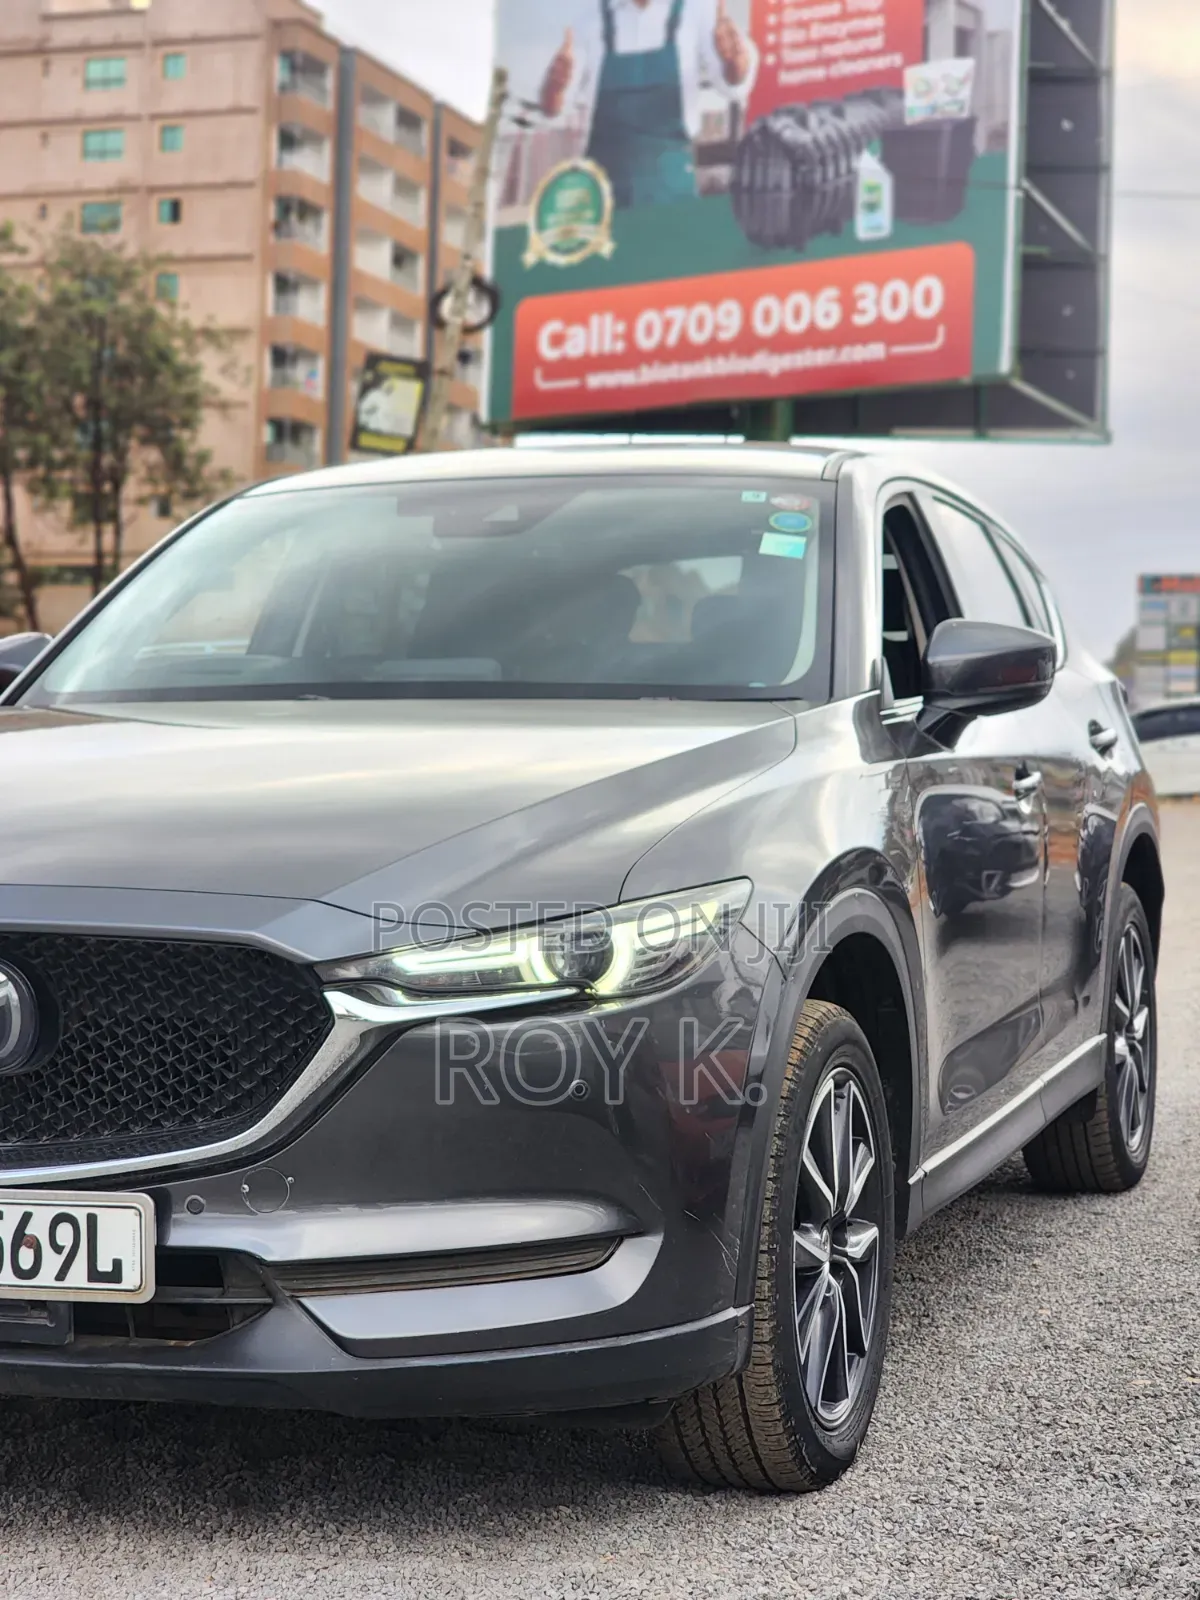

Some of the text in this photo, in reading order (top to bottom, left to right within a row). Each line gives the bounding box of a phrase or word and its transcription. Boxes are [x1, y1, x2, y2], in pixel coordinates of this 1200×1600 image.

[537, 275, 944, 361] Call: 0709 006 300
[0, 1210, 123, 1284] 69L
